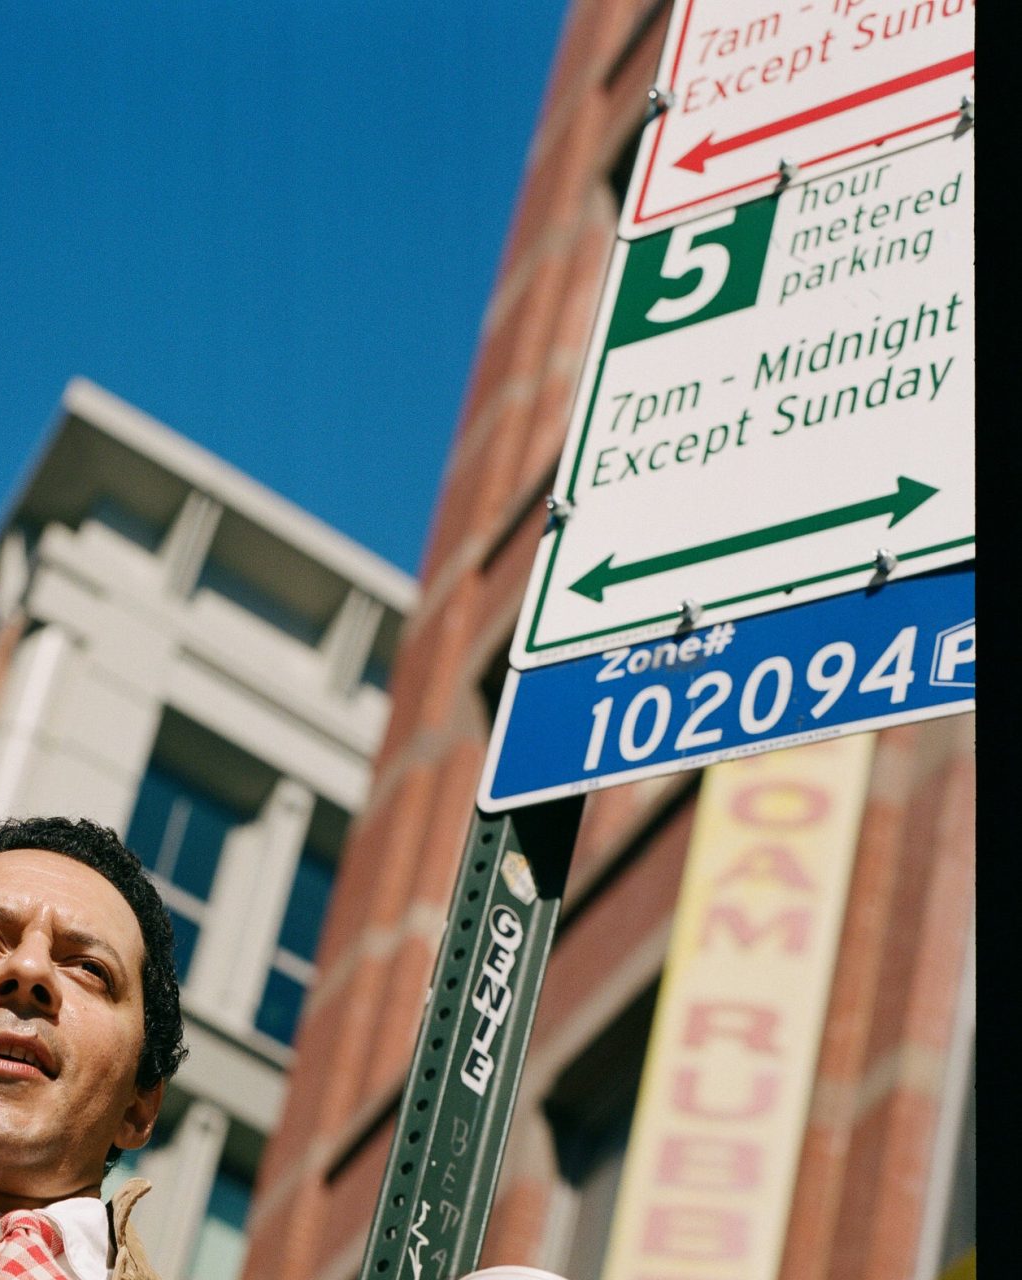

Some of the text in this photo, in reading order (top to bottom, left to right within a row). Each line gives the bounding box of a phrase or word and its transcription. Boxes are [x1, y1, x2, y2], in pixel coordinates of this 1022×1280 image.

[682, 28, 834, 114] Except
[697, 11, 781, 65] 7am
[790, 171, 963, 256] metered
[799, 164, 891, 214] hour
[645, 208, 737, 324] 5
[780, 229, 934, 306] parking
[610, 381, 702, 434] 7pm
[754, 292, 963, 391] Midnight
[592, 356, 955, 488] Except Sunday
[583, 625, 918, 771] 102094
[595, 622, 736, 684] Zone#
[700, 752, 832, 954] OAM
[461, 904, 523, 1096] GENIE
